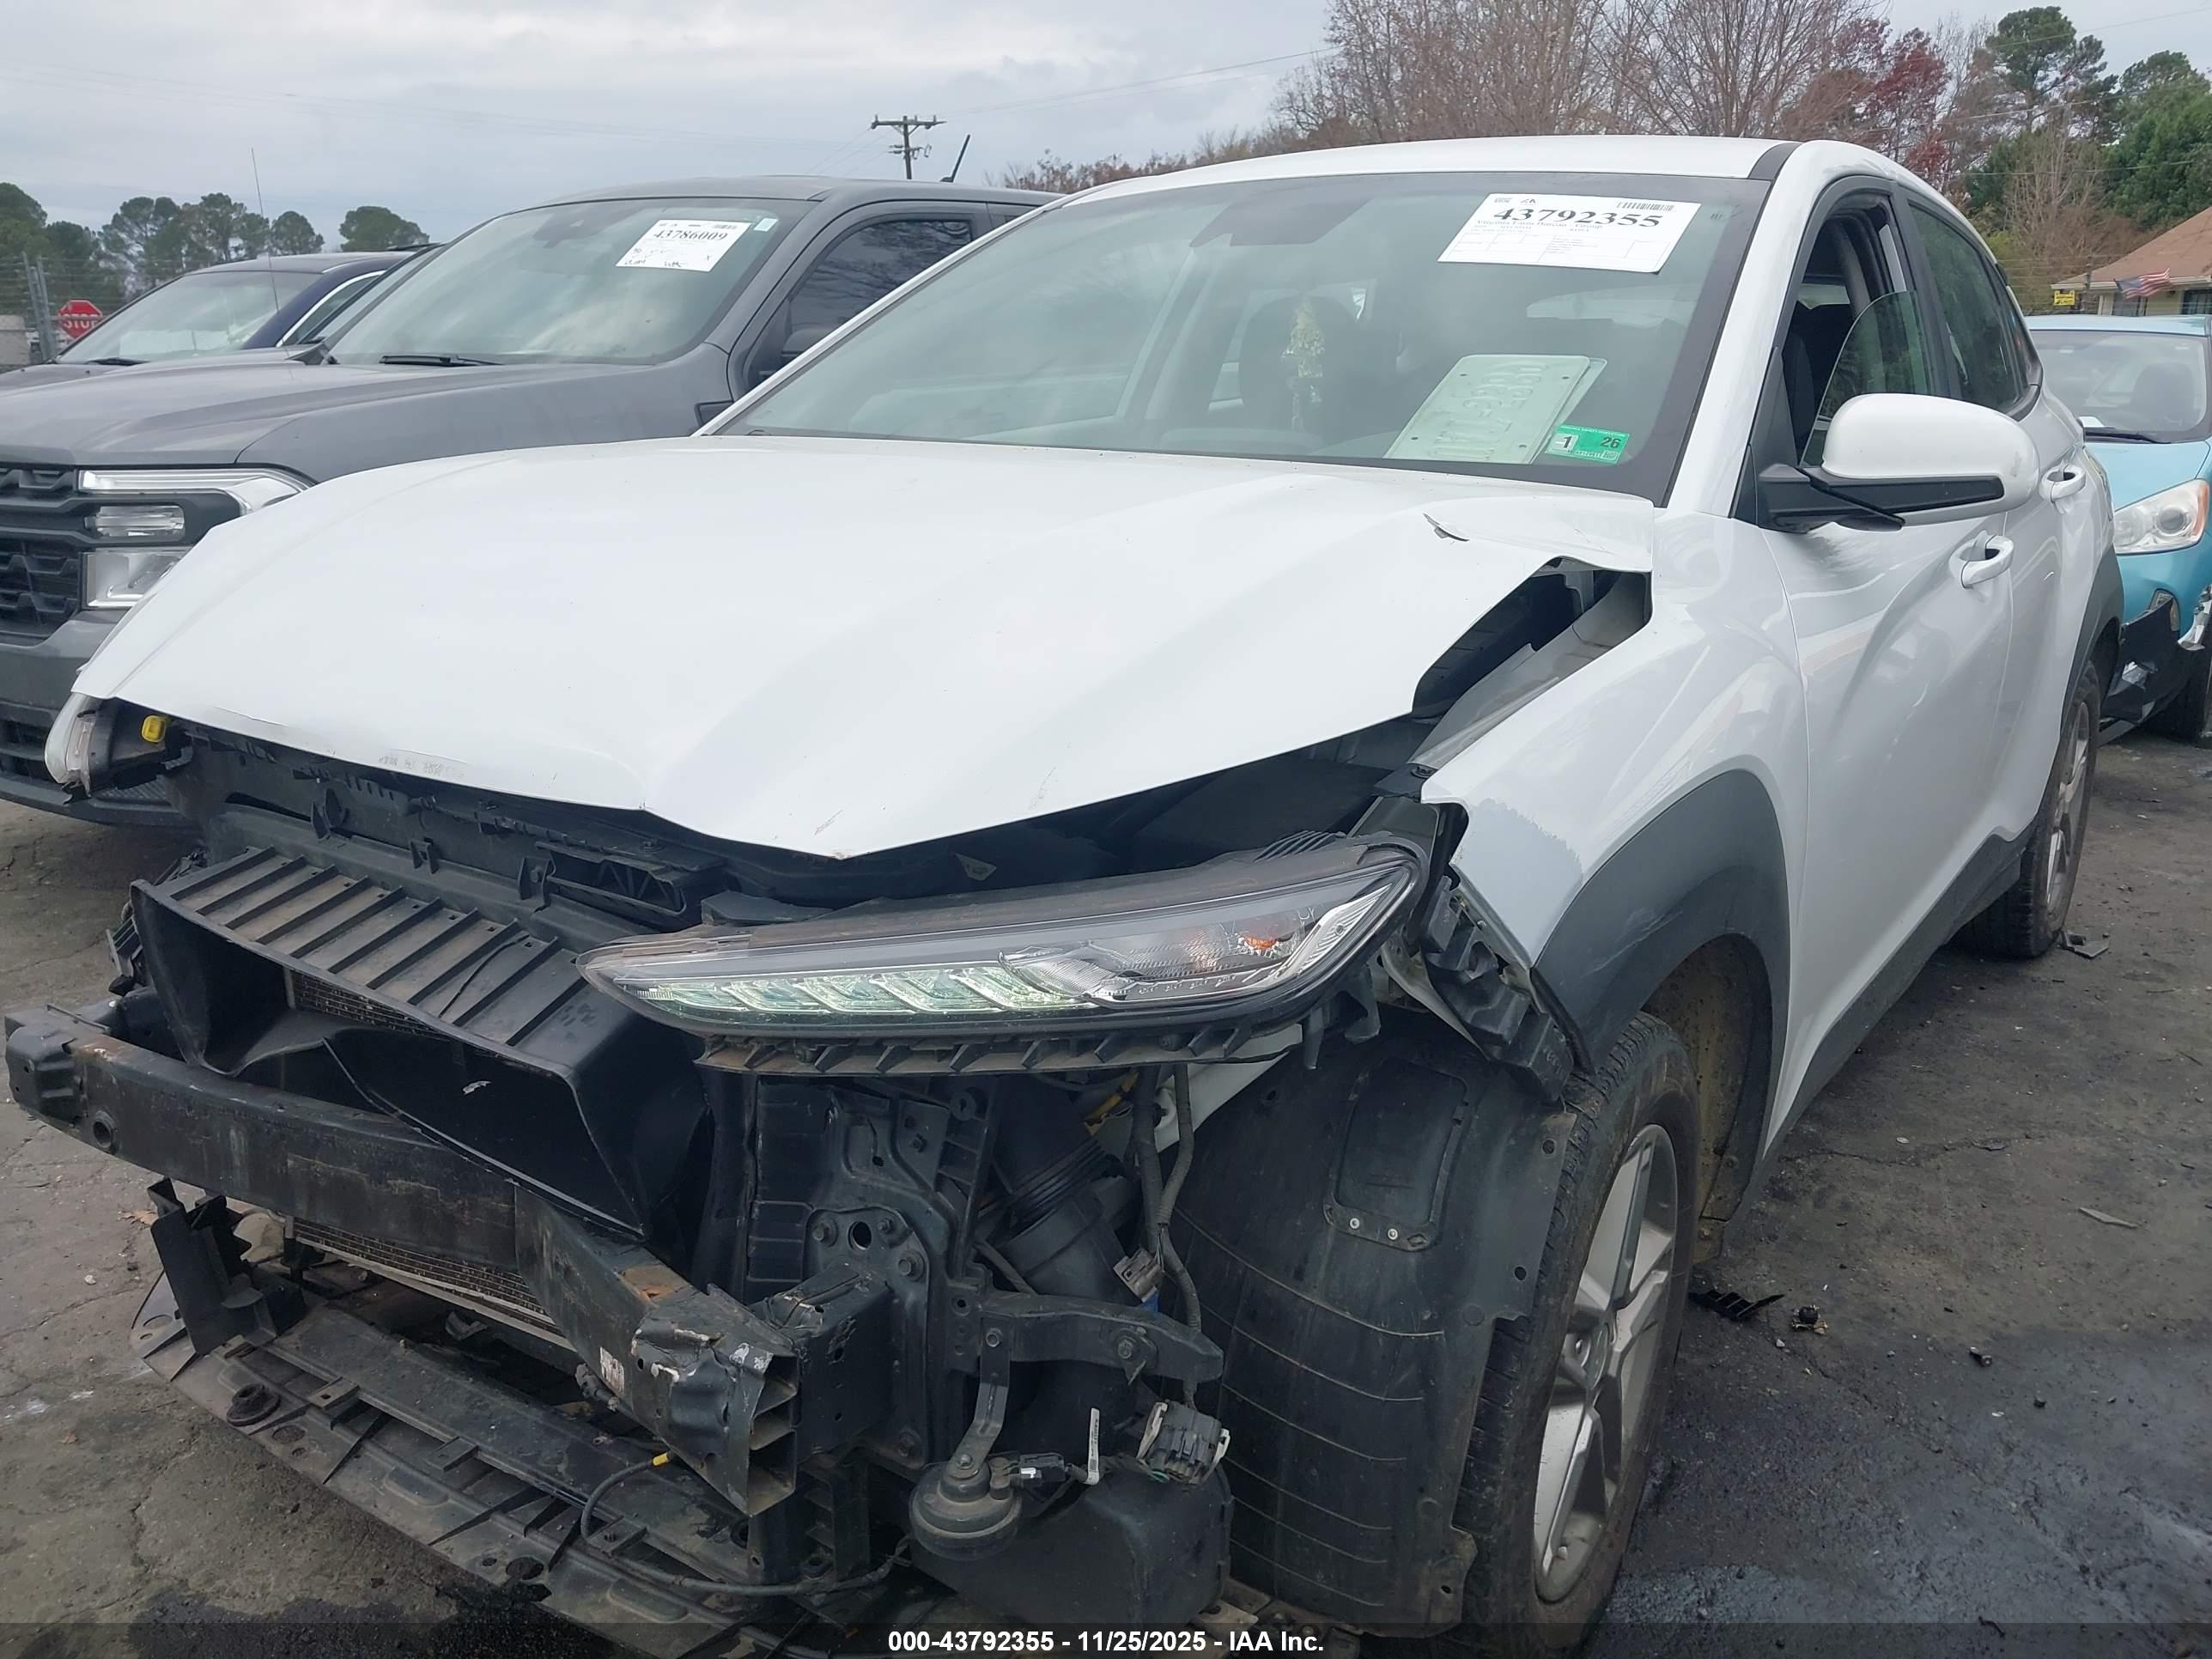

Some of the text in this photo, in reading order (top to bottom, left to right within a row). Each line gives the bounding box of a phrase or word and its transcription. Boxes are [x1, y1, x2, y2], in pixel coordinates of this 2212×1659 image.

[1493, 208, 1663, 228] 43792355
[653, 229, 728, 240] 43786009
[63, 313, 100, 329] STOP
[1563, 436, 1622, 448] 1 26
